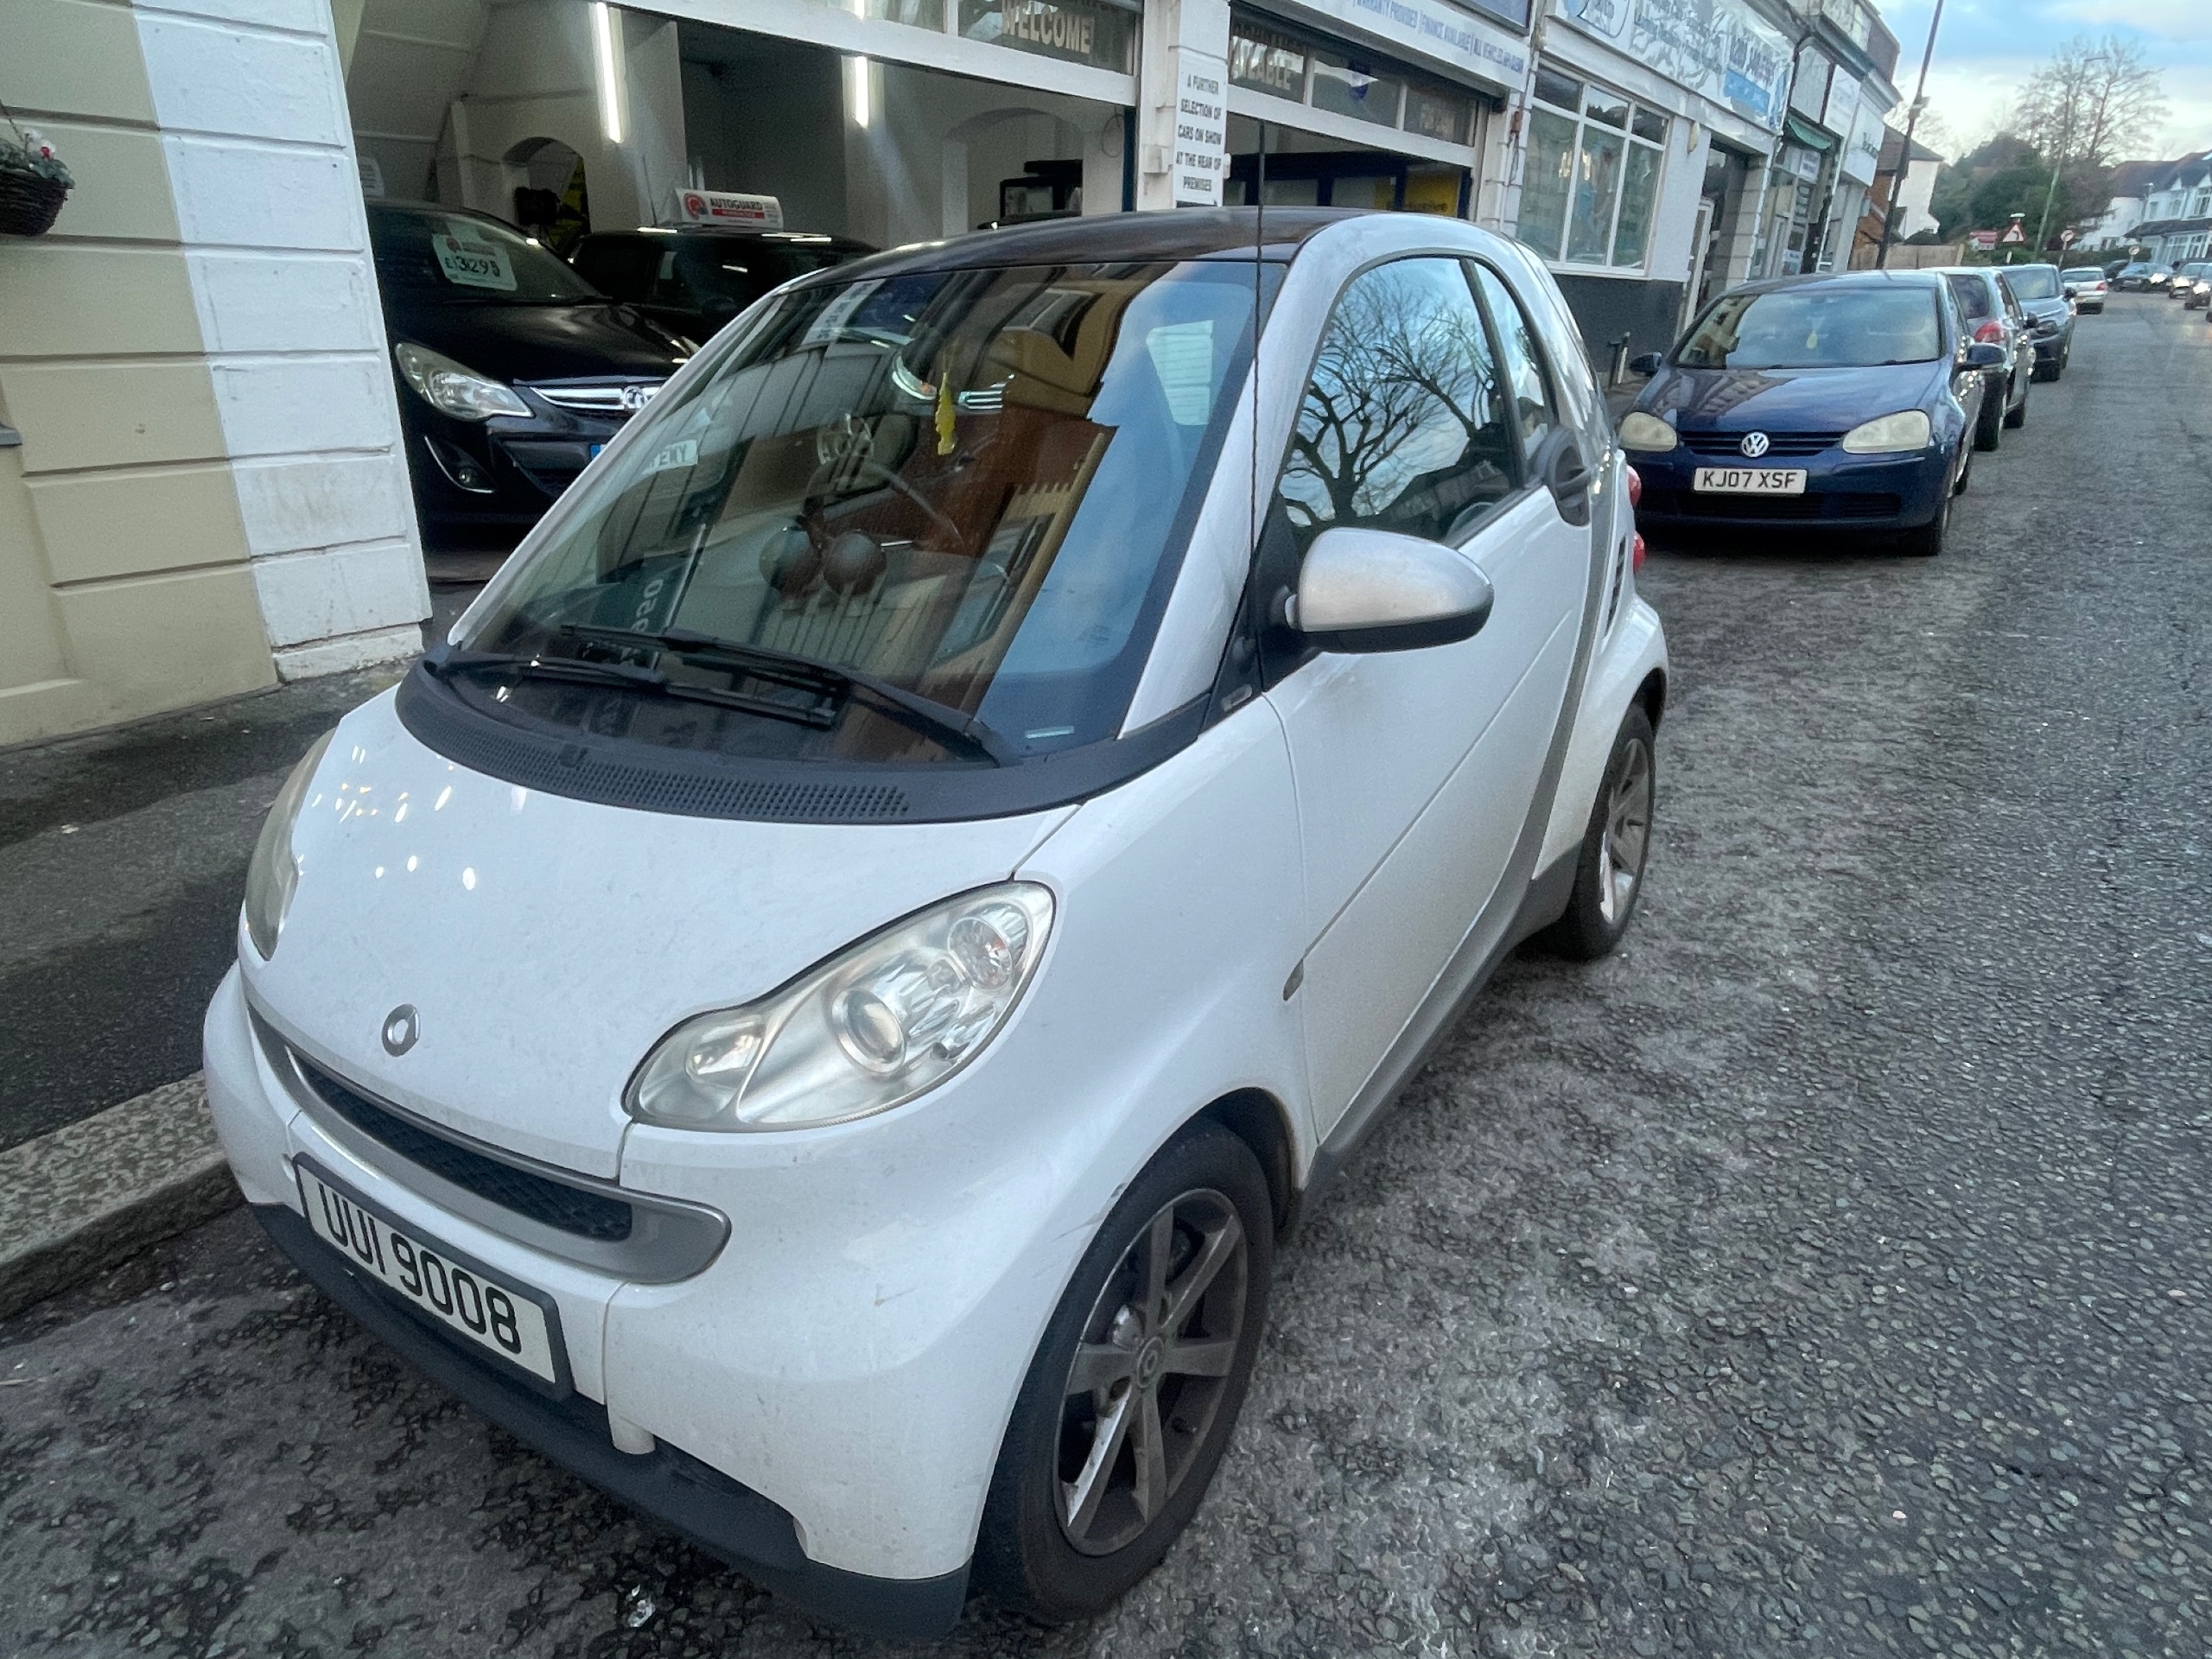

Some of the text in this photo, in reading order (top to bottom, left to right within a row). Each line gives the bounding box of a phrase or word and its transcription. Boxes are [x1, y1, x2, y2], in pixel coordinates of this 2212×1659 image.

[1001, 7, 1094, 54] WELCOME
[1187, 74, 1219, 95] A FURTHER
[1180, 98, 1222, 120] SELECTION OF
[1178, 124, 1223, 145] CARS ON SHOW
[1176, 150, 1222, 171] AT THE REAR OF
[1183, 175, 1212, 193] PREMISES
[709, 198, 764, 210] AUTOGUARD
[1701, 470, 1797, 489] KJ07 XSF
[318, 1181, 523, 1355] UUI 9008
